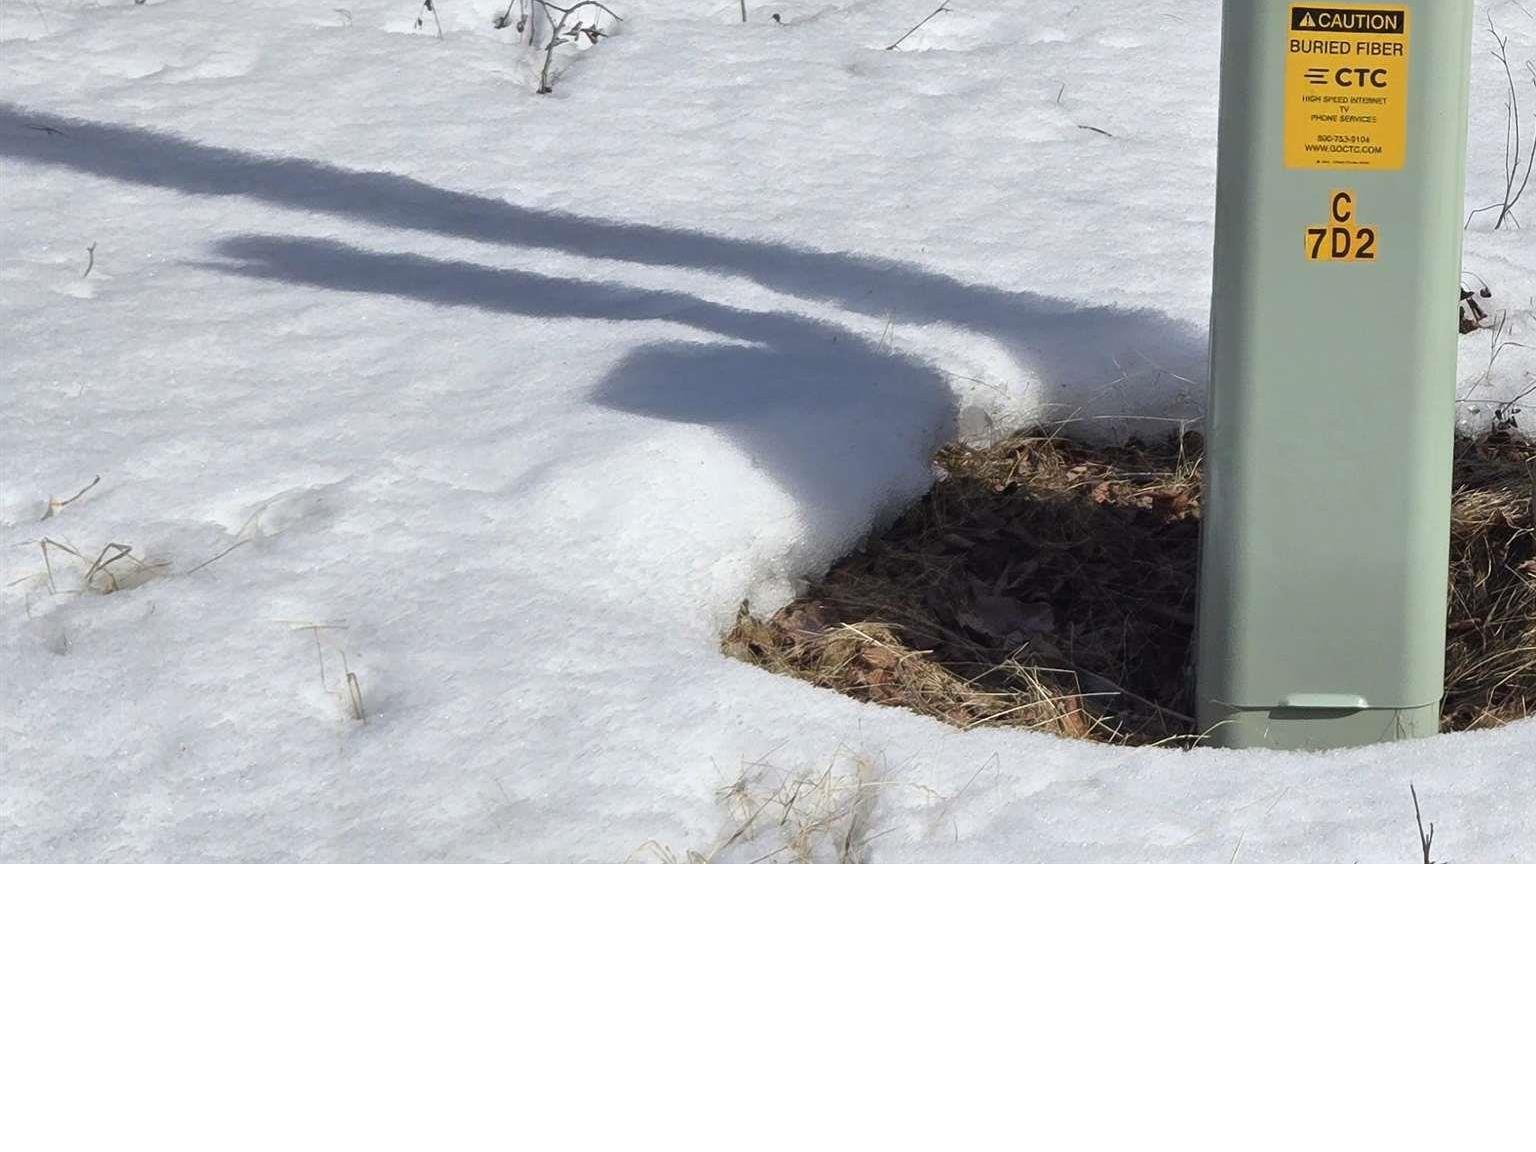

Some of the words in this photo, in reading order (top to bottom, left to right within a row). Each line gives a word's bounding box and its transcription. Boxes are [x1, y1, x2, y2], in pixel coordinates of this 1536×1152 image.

[1318, 12, 1398, 30] CAUTION
[1290, 39, 1350, 55] BURIED
[1356, 41, 1403, 56] FIBER
[1335, 67, 1387, 88] CTC
[1302, 95, 1321, 103] HIGH
[1323, 95, 1348, 104] SPEED
[1339, 105, 1350, 113] TV
[1311, 114, 1337, 122] PHONE
[1332, 191, 1352, 223] C
[1307, 227, 1375, 259] 7D2
